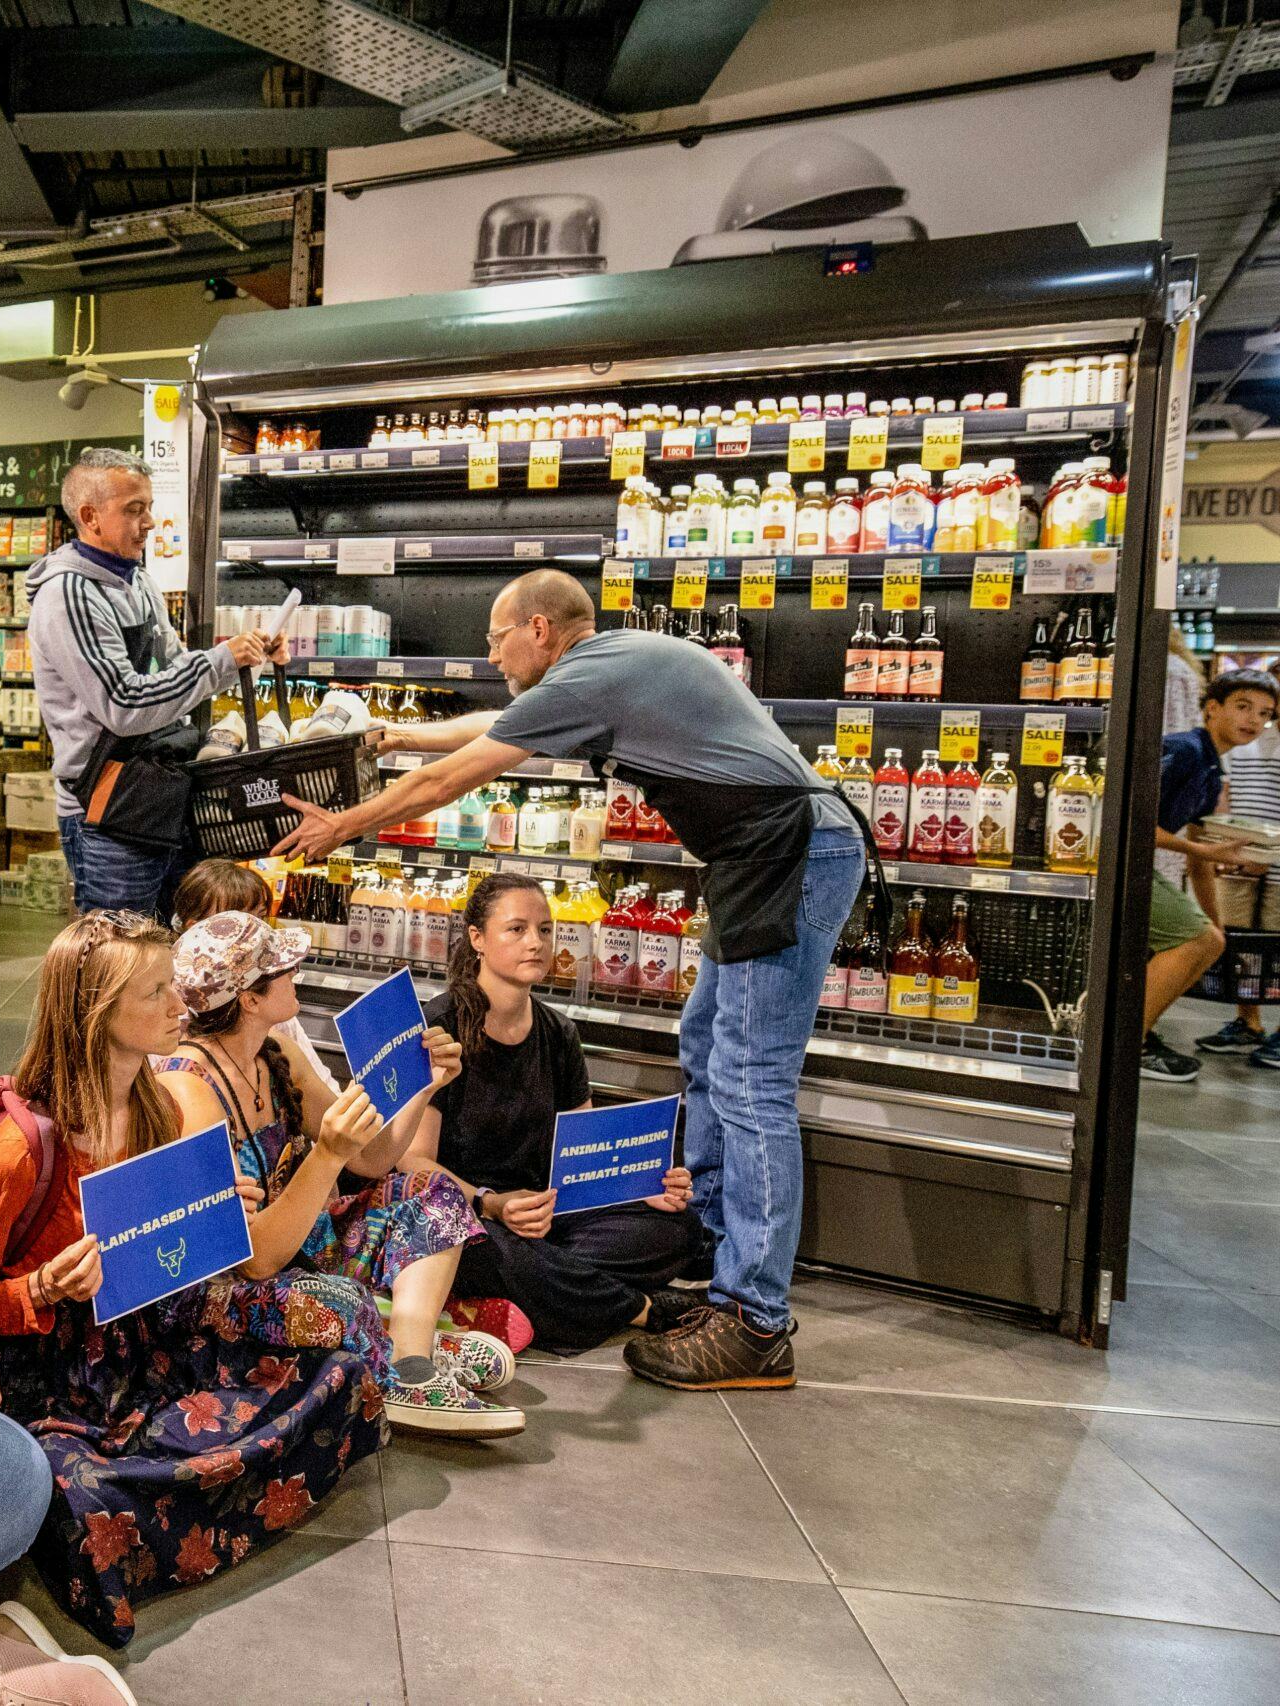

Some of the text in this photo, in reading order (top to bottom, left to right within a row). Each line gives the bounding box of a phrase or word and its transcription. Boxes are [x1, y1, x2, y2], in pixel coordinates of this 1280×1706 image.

[156, 398, 179, 409] SALE
[792, 437, 823, 447] SALE
[853, 434, 886, 445] SALE
[926, 434, 961, 445] SALE
[150, 440, 176, 458] 15%
[615, 446, 642, 456] SALE
[667, 448, 688, 456] LOCAL
[722, 443, 743, 452] LOCAL
[6, 456, 20, 476] &
[471, 457, 497, 467] SALE
[532, 456, 558, 465] SALE
[1181, 489, 1221, 517] IVE
[1226, 488, 1257, 516] BY
[604, 579, 632, 588] SALE
[676, 575, 706, 585] SALE
[743, 575, 774, 585] SALE
[814, 575, 846, 585] SALE
[886, 575, 919, 585] SALE
[976, 574, 1011, 584] SALE
[839, 724, 872, 735] SALE
[942, 726, 978, 737] SALE
[1025, 730, 1063, 741] SALE
[242, 779, 280, 795] WHOLE
[246, 789, 280, 801] FOODS
[878, 796, 904, 804] KARMA
[1058, 806, 1087, 814] KARMA
[574, 829, 584, 840] LA
[329, 857, 353, 868] SALE
[377, 861, 401, 870] SALE
[604, 938, 631, 948] KARMA
[642, 944, 668, 953] KARMA
[849, 987, 885, 998] KOMBUCHA
[901, 992, 932, 1005] KOMBUC
[355, 1022, 424, 1084] PLANT-BASED FUTURE
[560, 1130, 669, 1158] ANIMAL FARMING
[562, 1158, 662, 1185] CLIMATE CRISIS
[187, 1186, 236, 1216] FUTURE
